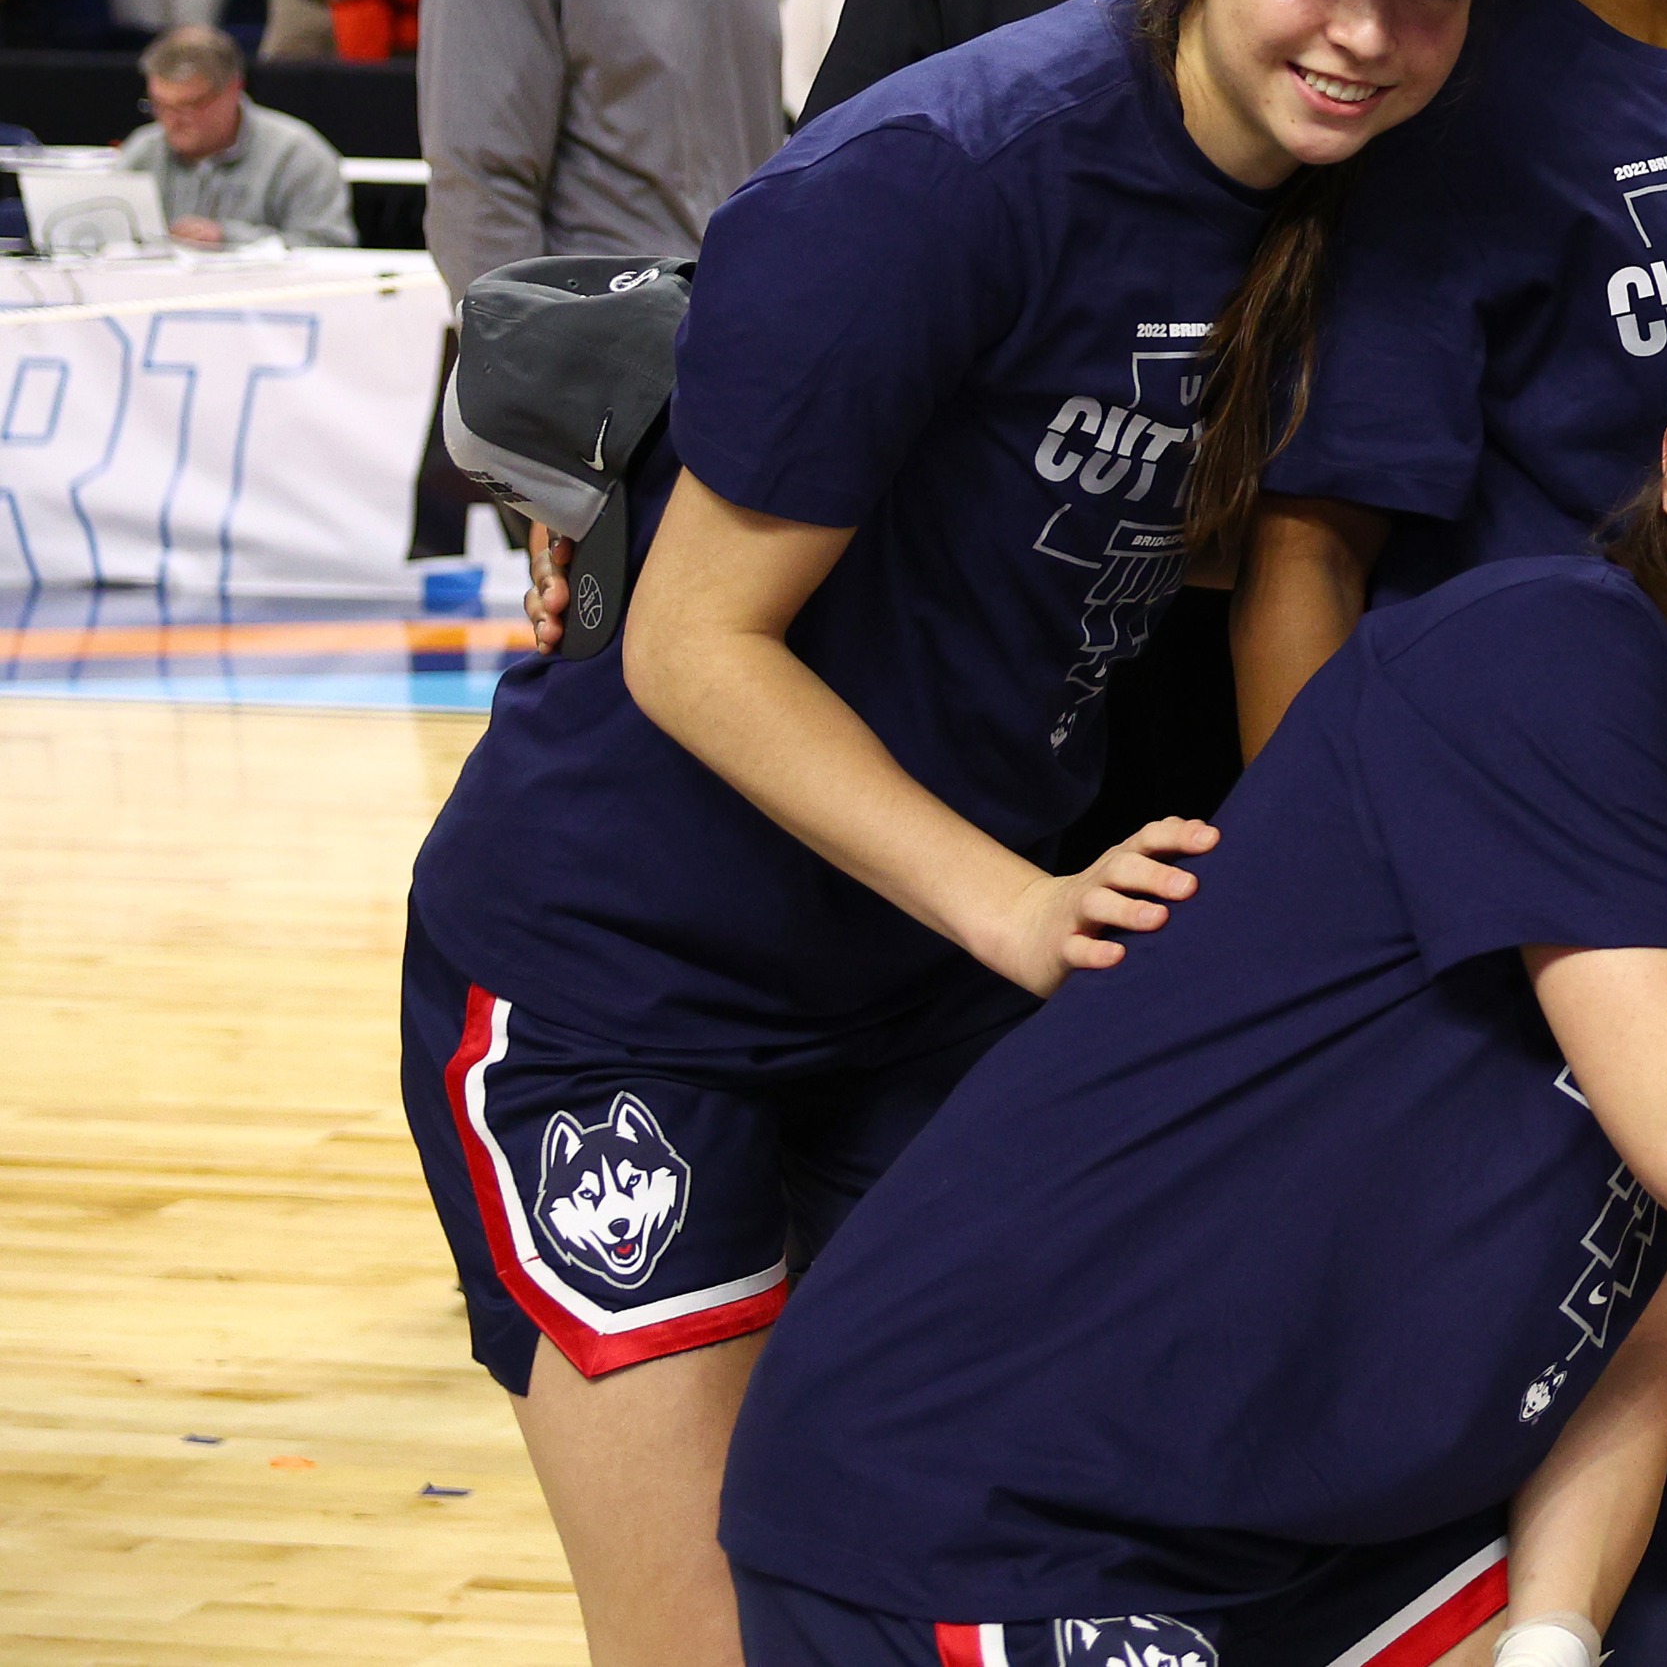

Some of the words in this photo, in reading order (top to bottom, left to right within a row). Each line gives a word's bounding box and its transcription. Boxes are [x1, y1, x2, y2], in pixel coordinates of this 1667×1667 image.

[1614, 161, 1649, 181] 2022
[1136, 323, 1168, 337] 2022
[1034, 394, 1189, 502] CUT
